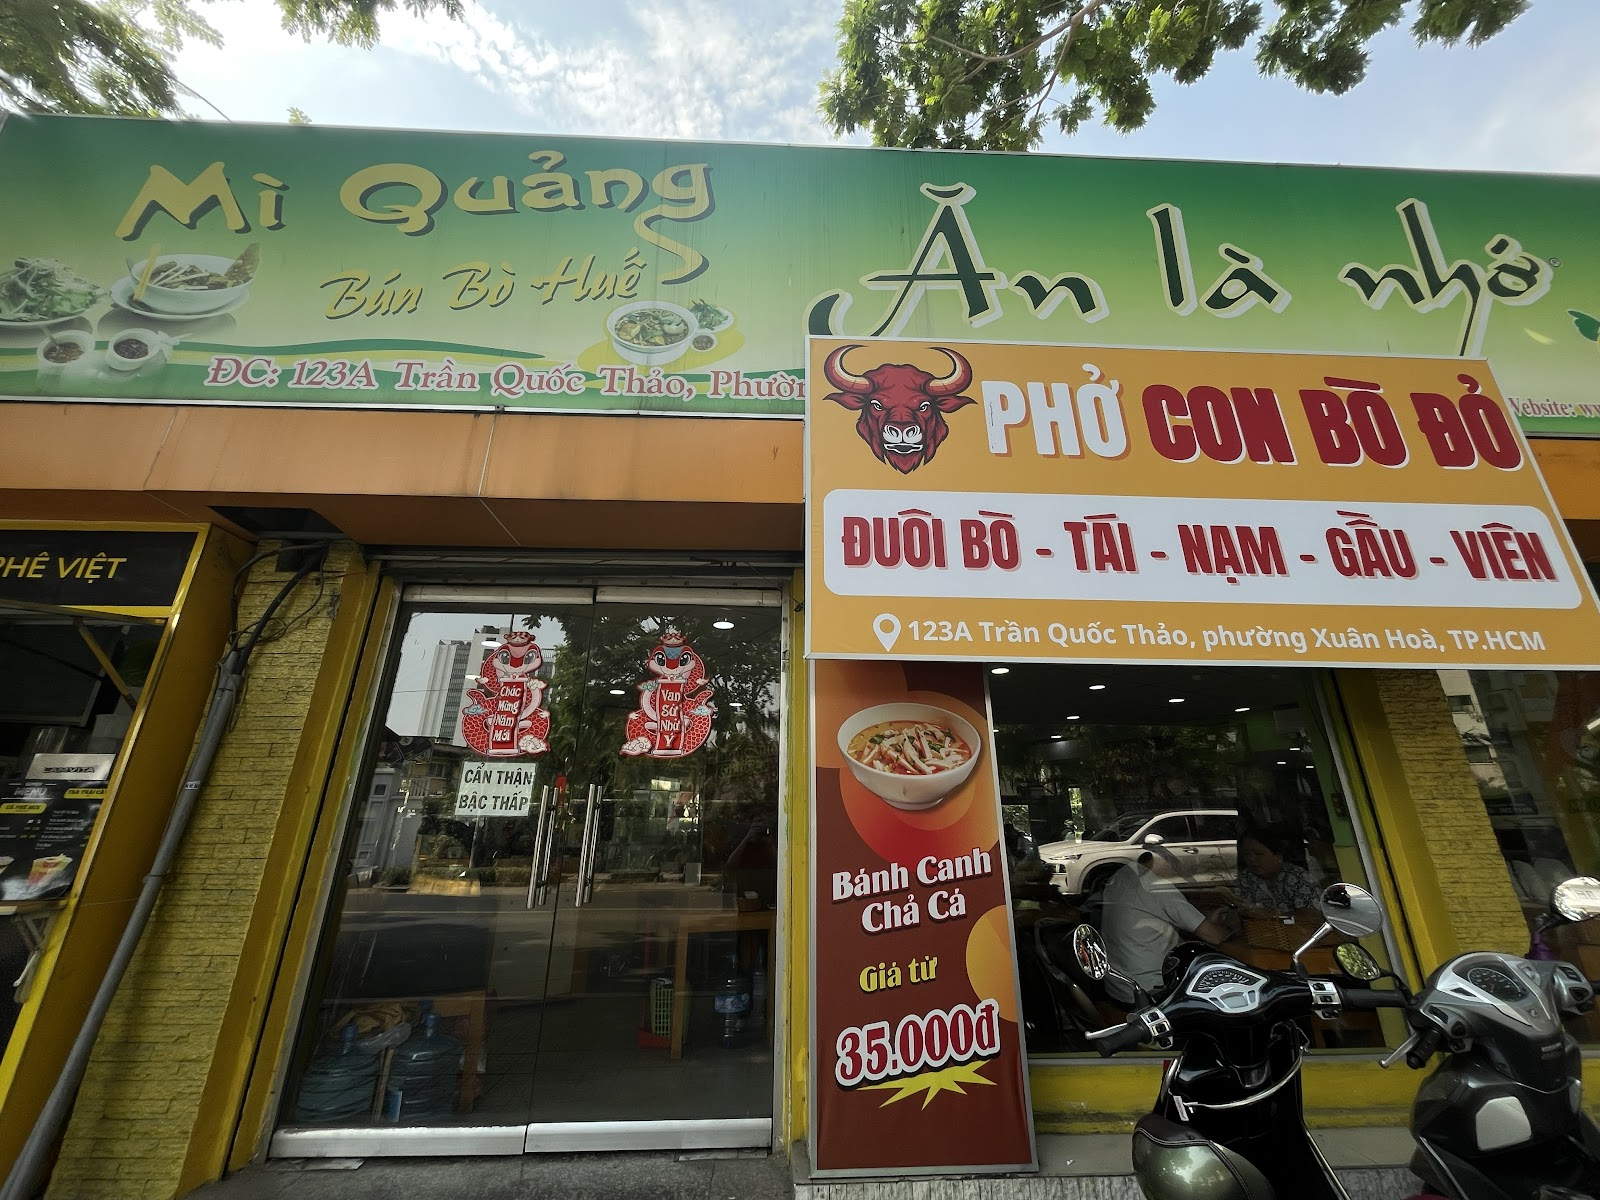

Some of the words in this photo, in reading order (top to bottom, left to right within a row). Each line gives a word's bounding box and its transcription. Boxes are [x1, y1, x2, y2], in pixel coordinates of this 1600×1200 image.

[115, 161, 290, 241] Mì
[339, 150, 715, 285] Quảng
[319, 270, 424, 320] Bún
[442, 261, 516, 311] Bò
[530, 246, 648, 305] Huế
[804, 182, 1110, 336] Ăn
[1146, 203, 1292, 318] là
[1338, 198, 1554, 356] nhở
[204, 356, 279, 389] ĐC:
[288, 358, 379, 391] 123A
[394, 357, 479, 393] Trần
[489, 362, 587, 399] Quốc
[599, 364, 696, 402] Thảo,
[980, 363, 1133, 460] PHỞ
[1141, 384, 1300, 466] CON
[1299, 376, 1411, 470] BÒ
[1409, 373, 1526, 473] ĐỎ
[0, 551, 50, 578] HÊ
[58, 551, 128, 584] VIỆT
[841, 508, 949, 571] ĐUÔI
[959, 510, 1022, 571] BÒ
[1063, 513, 1139, 574] TÁI
[1177, 524, 1290, 586] NẠM
[1325, 510, 1419, 580] GẦU
[1449, 522, 1560, 582] VIÊN
[908, 620, 974, 642] 123A
[978, 619, 1040, 643] Trần
[1047, 621, 1117, 649] Quốc
[1123, 622, 1196, 649] Thảo,
[1203, 625, 1308, 654] phường
[1315, 629, 1379, 650] Xuân
[1386, 628, 1446, 653] Hoà,
[1447, 630, 1546, 651] TP.HCM
[464, 762, 493, 785] CẨN
[497, 767, 533, 788] THẬN
[459, 791, 488, 812] BẬC
[493, 791, 529, 811] THẤP
[832, 862, 910, 901] Bánh
[916, 847, 992, 885] Canh
[861, 893, 920, 933] Chả
[927, 888, 967, 921] Cá
[859, 962, 902, 993] Giá
[908, 955, 938, 983] từ
[835, 998, 1000, 1088] 35.000đ
